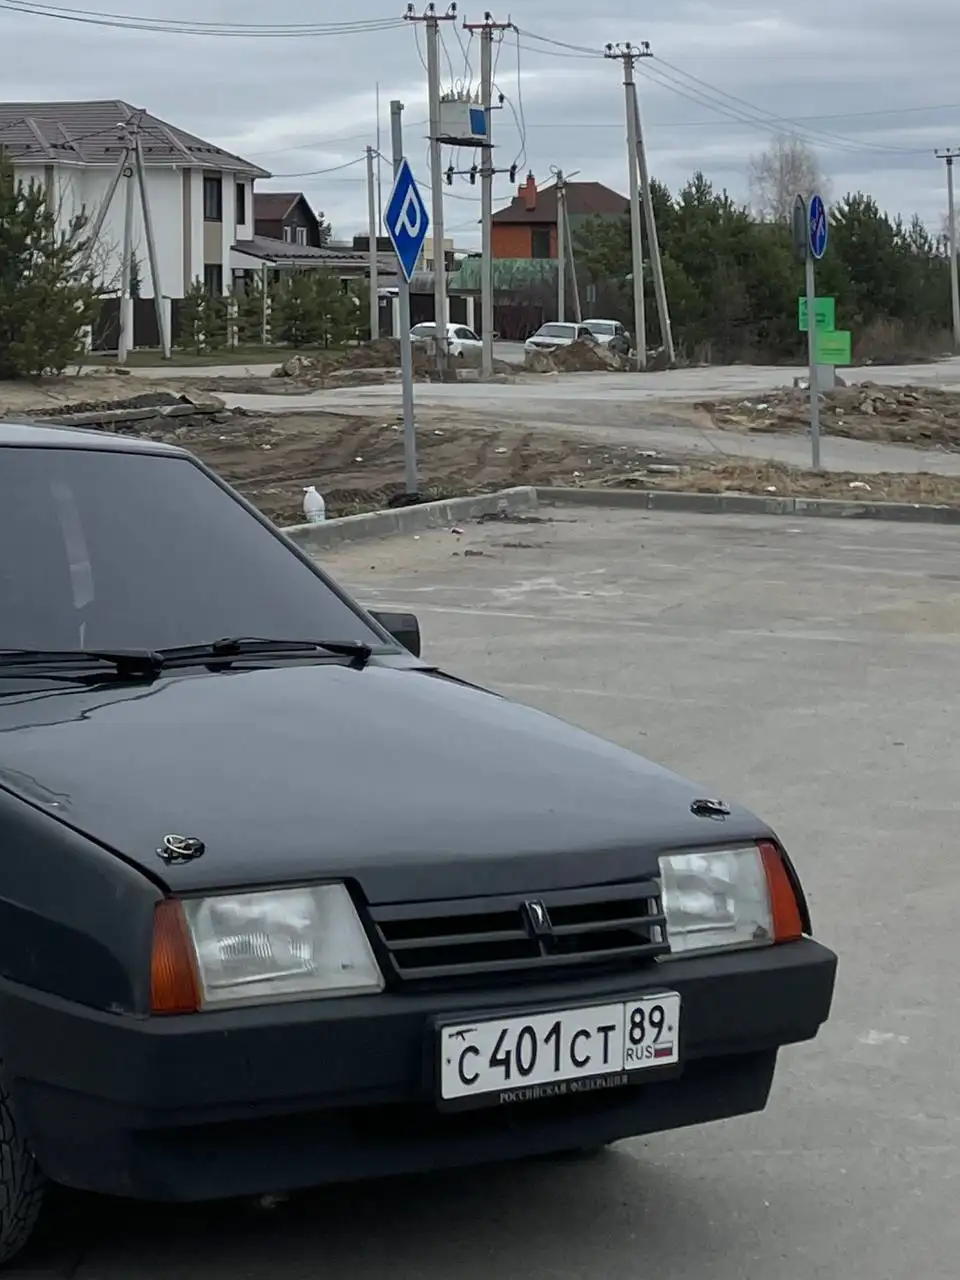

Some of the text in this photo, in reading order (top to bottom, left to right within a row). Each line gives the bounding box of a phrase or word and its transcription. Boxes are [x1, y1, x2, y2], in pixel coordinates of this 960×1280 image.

[394, 184, 422, 238] P
[629, 1004, 665, 1045] 89
[625, 1045, 653, 1062] RUS
